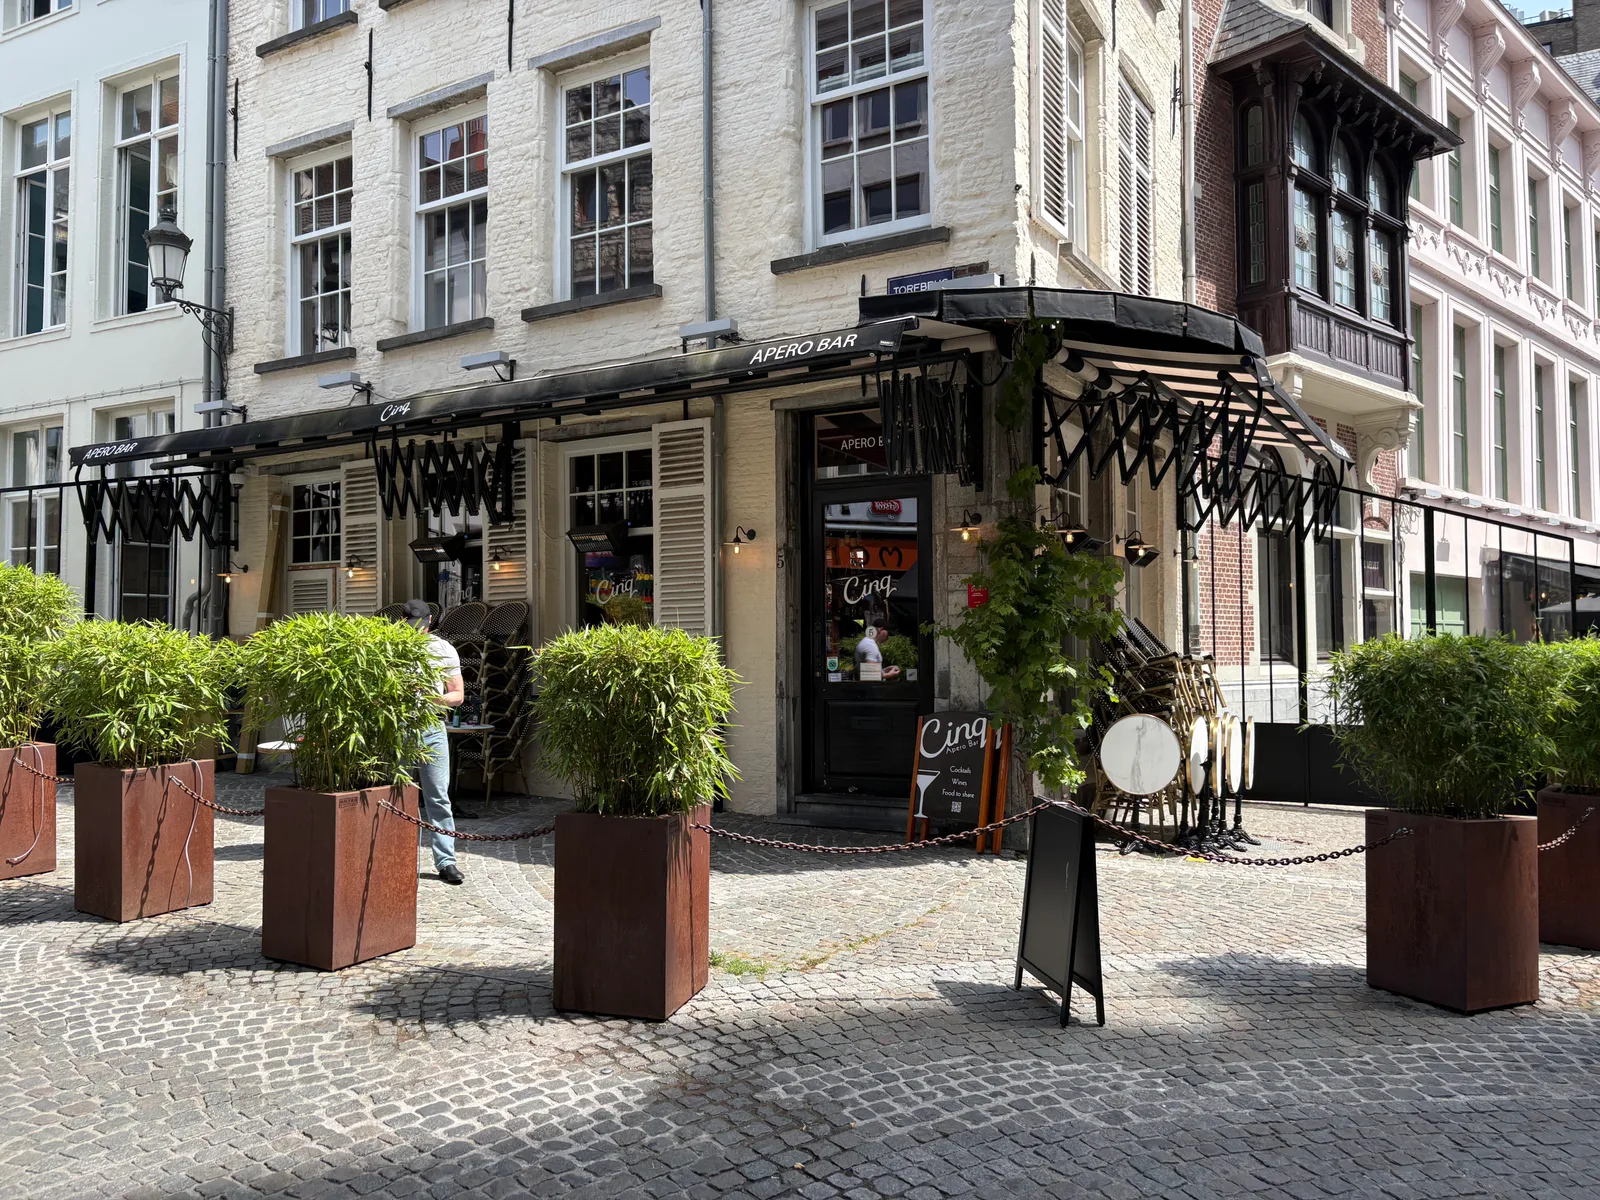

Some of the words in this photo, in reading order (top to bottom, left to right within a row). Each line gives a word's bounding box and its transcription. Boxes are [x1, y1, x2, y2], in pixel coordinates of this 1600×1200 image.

[749, 341, 814, 365] APERO
[816, 334, 858, 352] BAR
[380, 401, 411, 422] Cinq
[82, 445, 117, 460] APERO
[114, 442, 138, 455] BAR
[840, 436, 876, 451] APERO
[776, 554, 785, 569] 5
[596, 578, 639, 605] Cinq
[843, 574, 898, 605] Cinq
[919, 717, 988, 759] Cinq
[945, 744, 967, 755] Apero
[967, 739, 979, 748] Bar
[949, 765, 972, 774] Cocktails
[951, 778, 968, 786] Wines
[941, 788, 955, 797] Food
[962, 790, 975, 799] share
